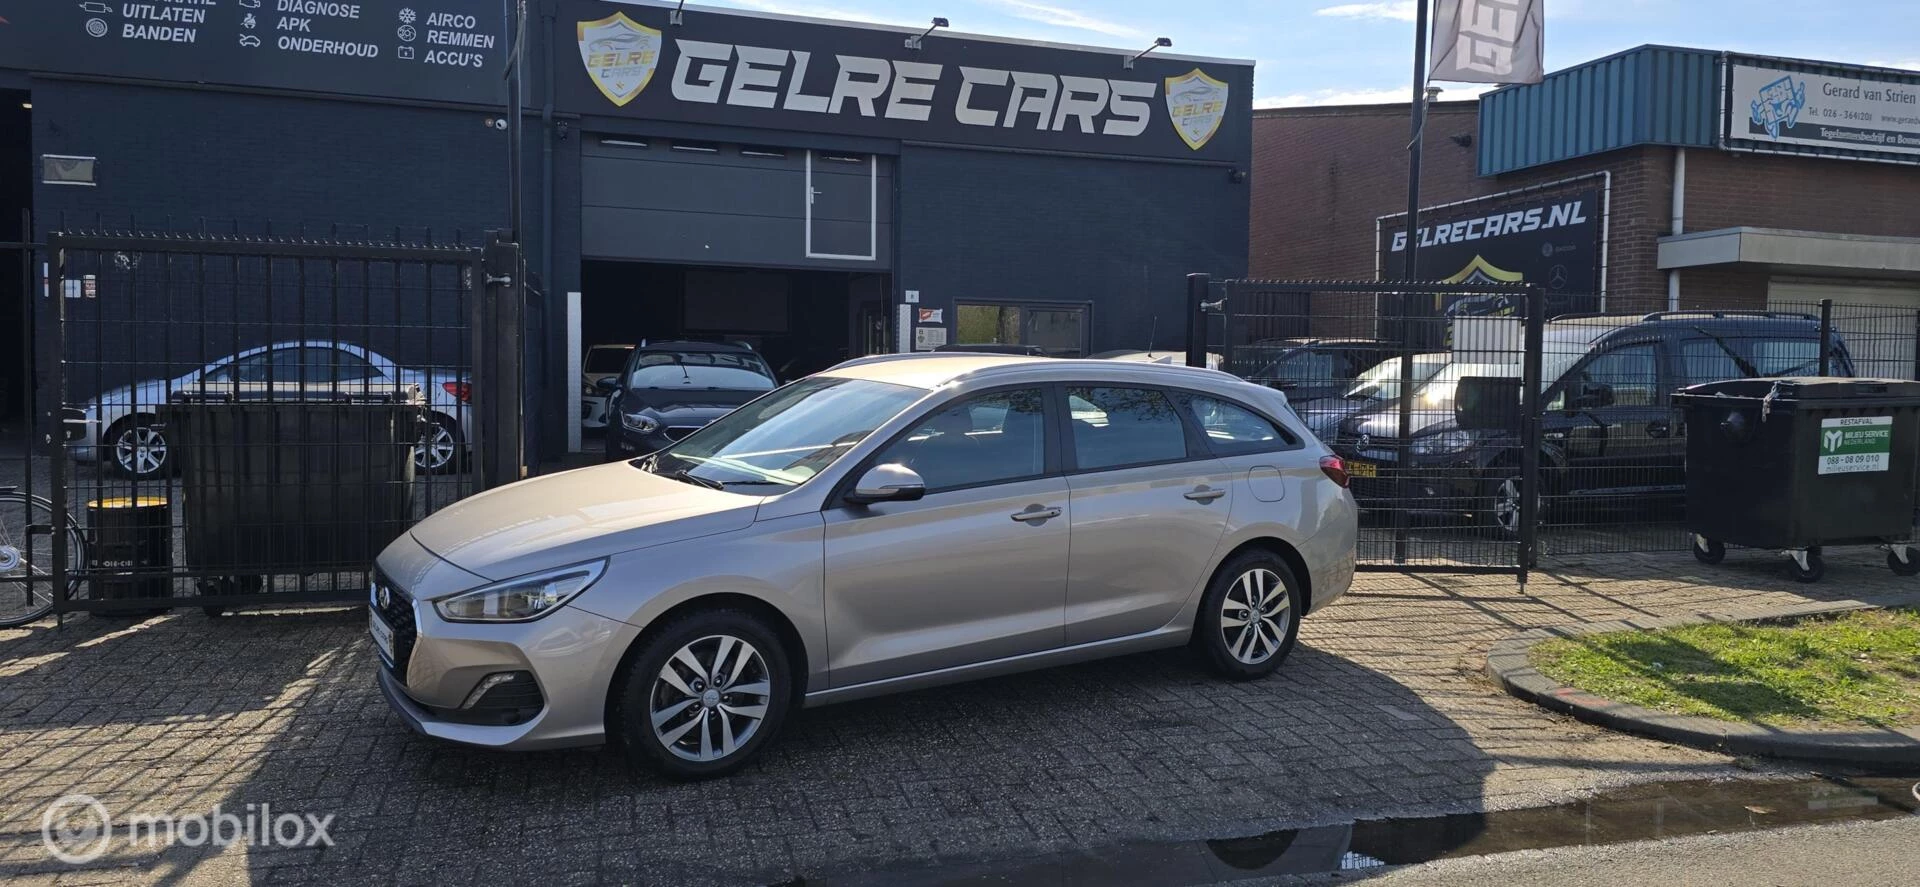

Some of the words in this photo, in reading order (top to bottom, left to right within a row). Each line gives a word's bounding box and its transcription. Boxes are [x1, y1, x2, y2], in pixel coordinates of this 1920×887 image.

[122, 3, 206, 23] UITLATEN
[277, 0, 361, 19] DIAGNOSE
[276, 16, 312, 32] APK
[426, 12, 476, 29] AIRCO
[122, 23, 197, 43] BANDEN
[427, 30, 495, 49] REMMEN
[1455, 0, 1519, 76] GE
[278, 36, 379, 58] ONDERHOUD
[424, 50, 484, 68] ACCU'S
[671, 39, 943, 121] GELRE
[955, 66, 1158, 137] CARS
[1823, 82, 1860, 99] Gerard
[1864, 89, 1882, 101] van
[1886, 89, 1916, 104] Strien
[1823, 108, 1837, 118] 026
